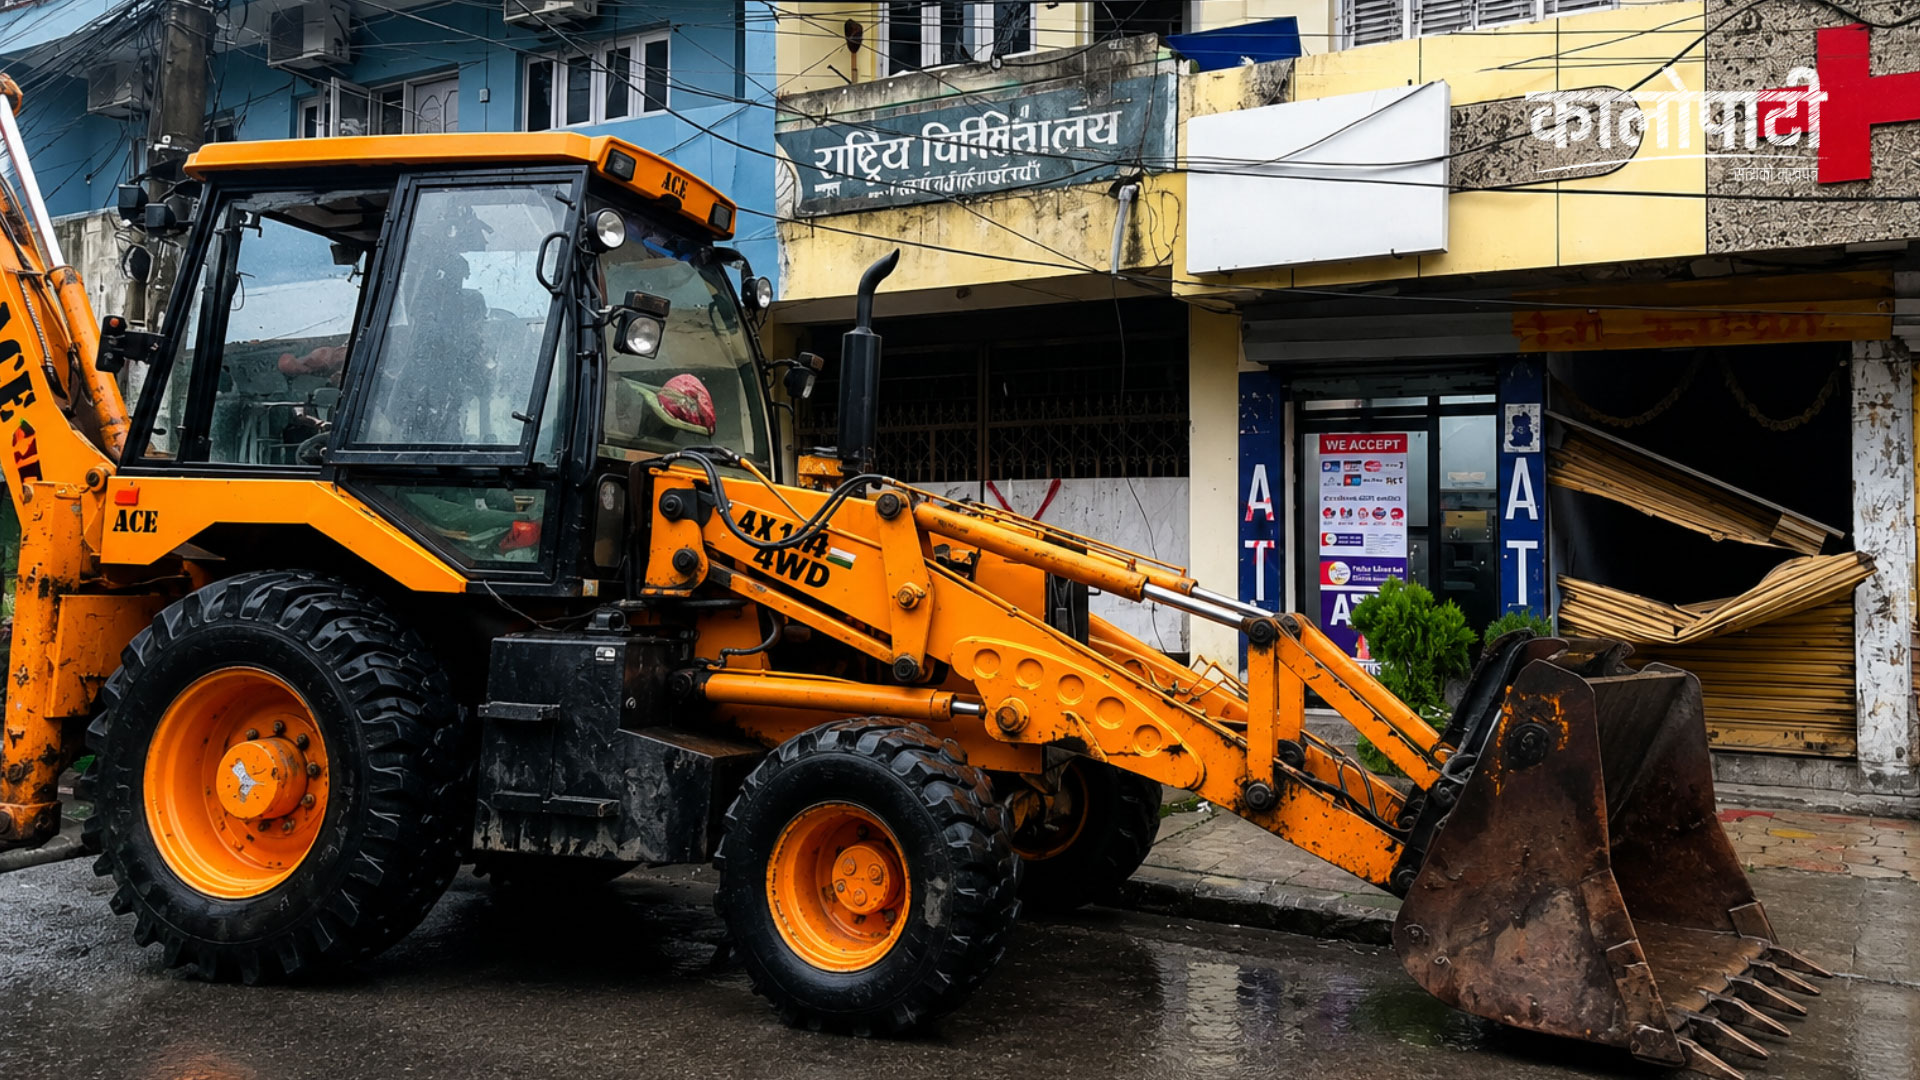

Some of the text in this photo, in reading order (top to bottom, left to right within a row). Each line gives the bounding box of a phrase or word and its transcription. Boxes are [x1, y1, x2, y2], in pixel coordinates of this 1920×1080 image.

[661, 172, 688, 200] ACE
[1326, 440, 1400, 450] WE ACCEPT
[113, 510, 158, 533] ACE
[753, 547, 830, 588] 4WD
